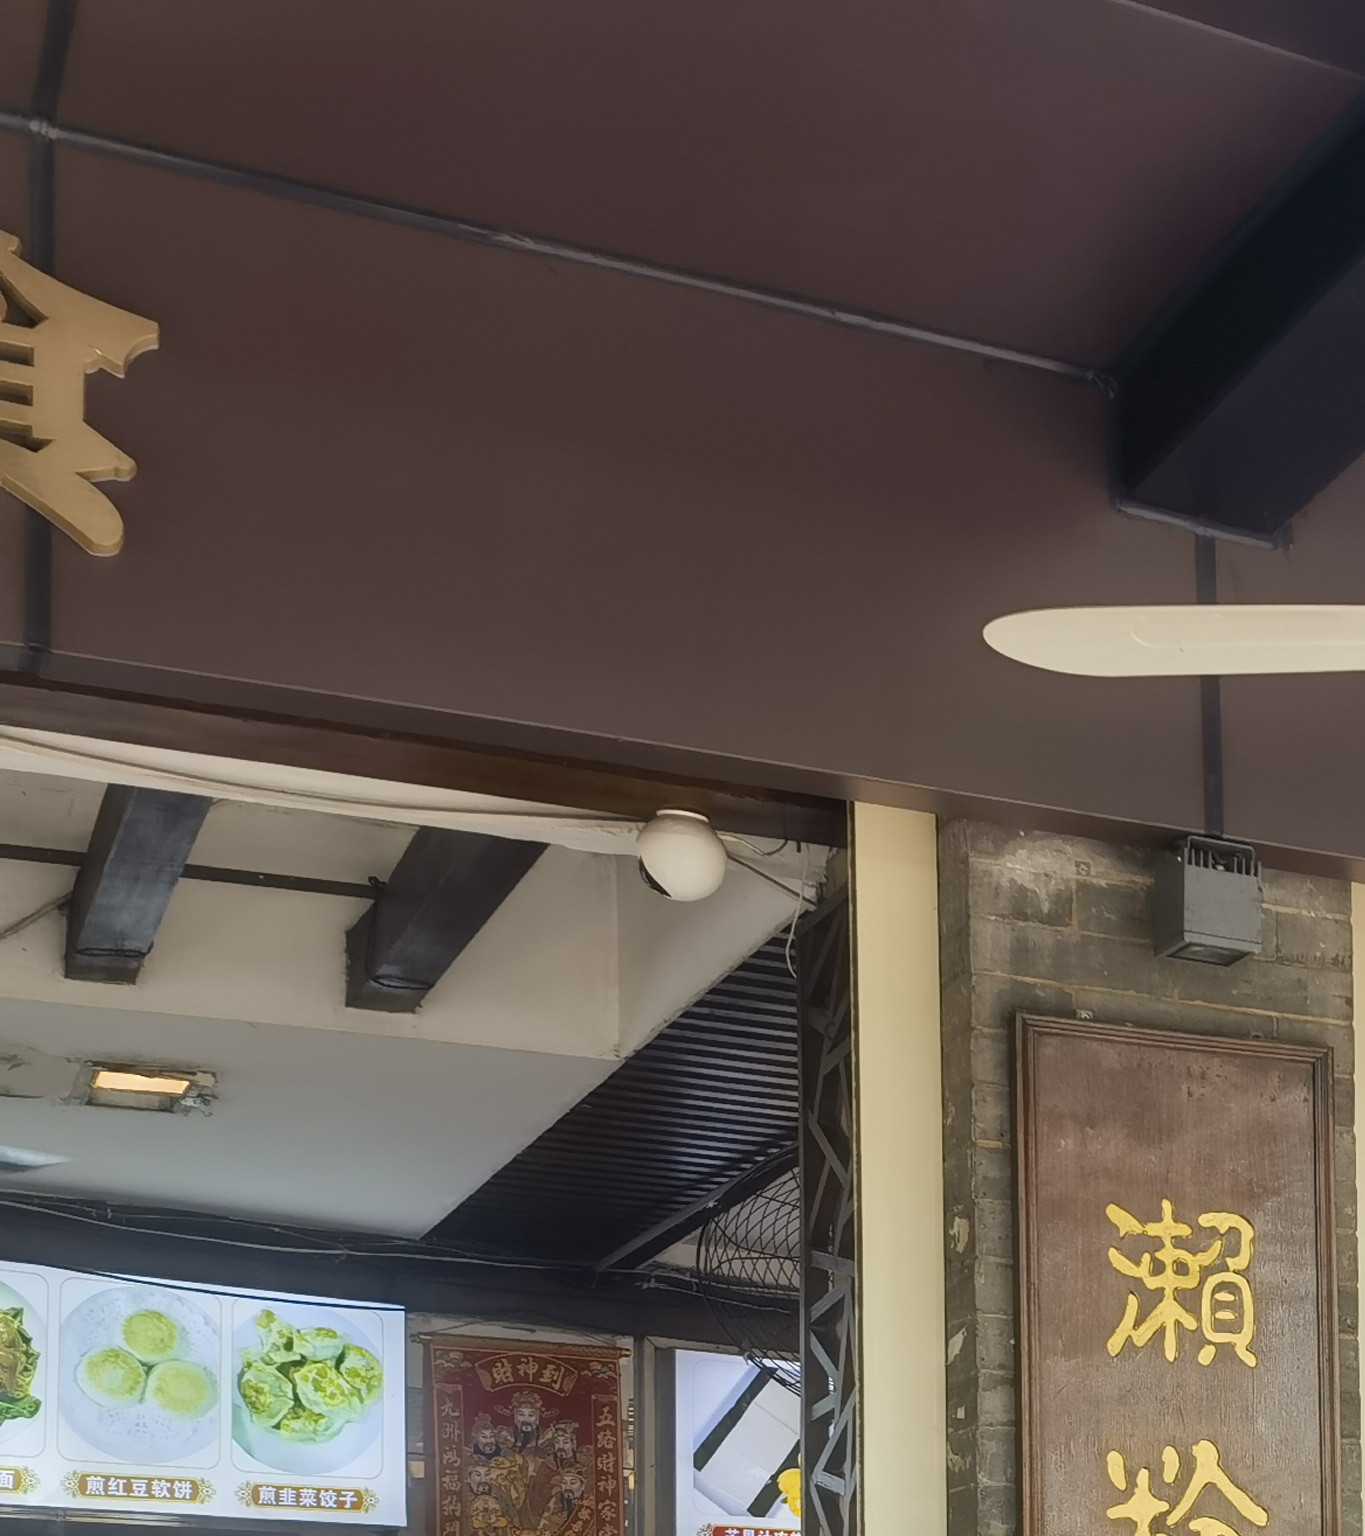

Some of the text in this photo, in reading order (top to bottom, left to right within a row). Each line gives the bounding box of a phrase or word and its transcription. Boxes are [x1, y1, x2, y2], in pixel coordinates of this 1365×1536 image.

[84, 1475, 194, 1500] 煎红豆软饼
[257, 1486, 358, 1508] 煎韭菜饺子
